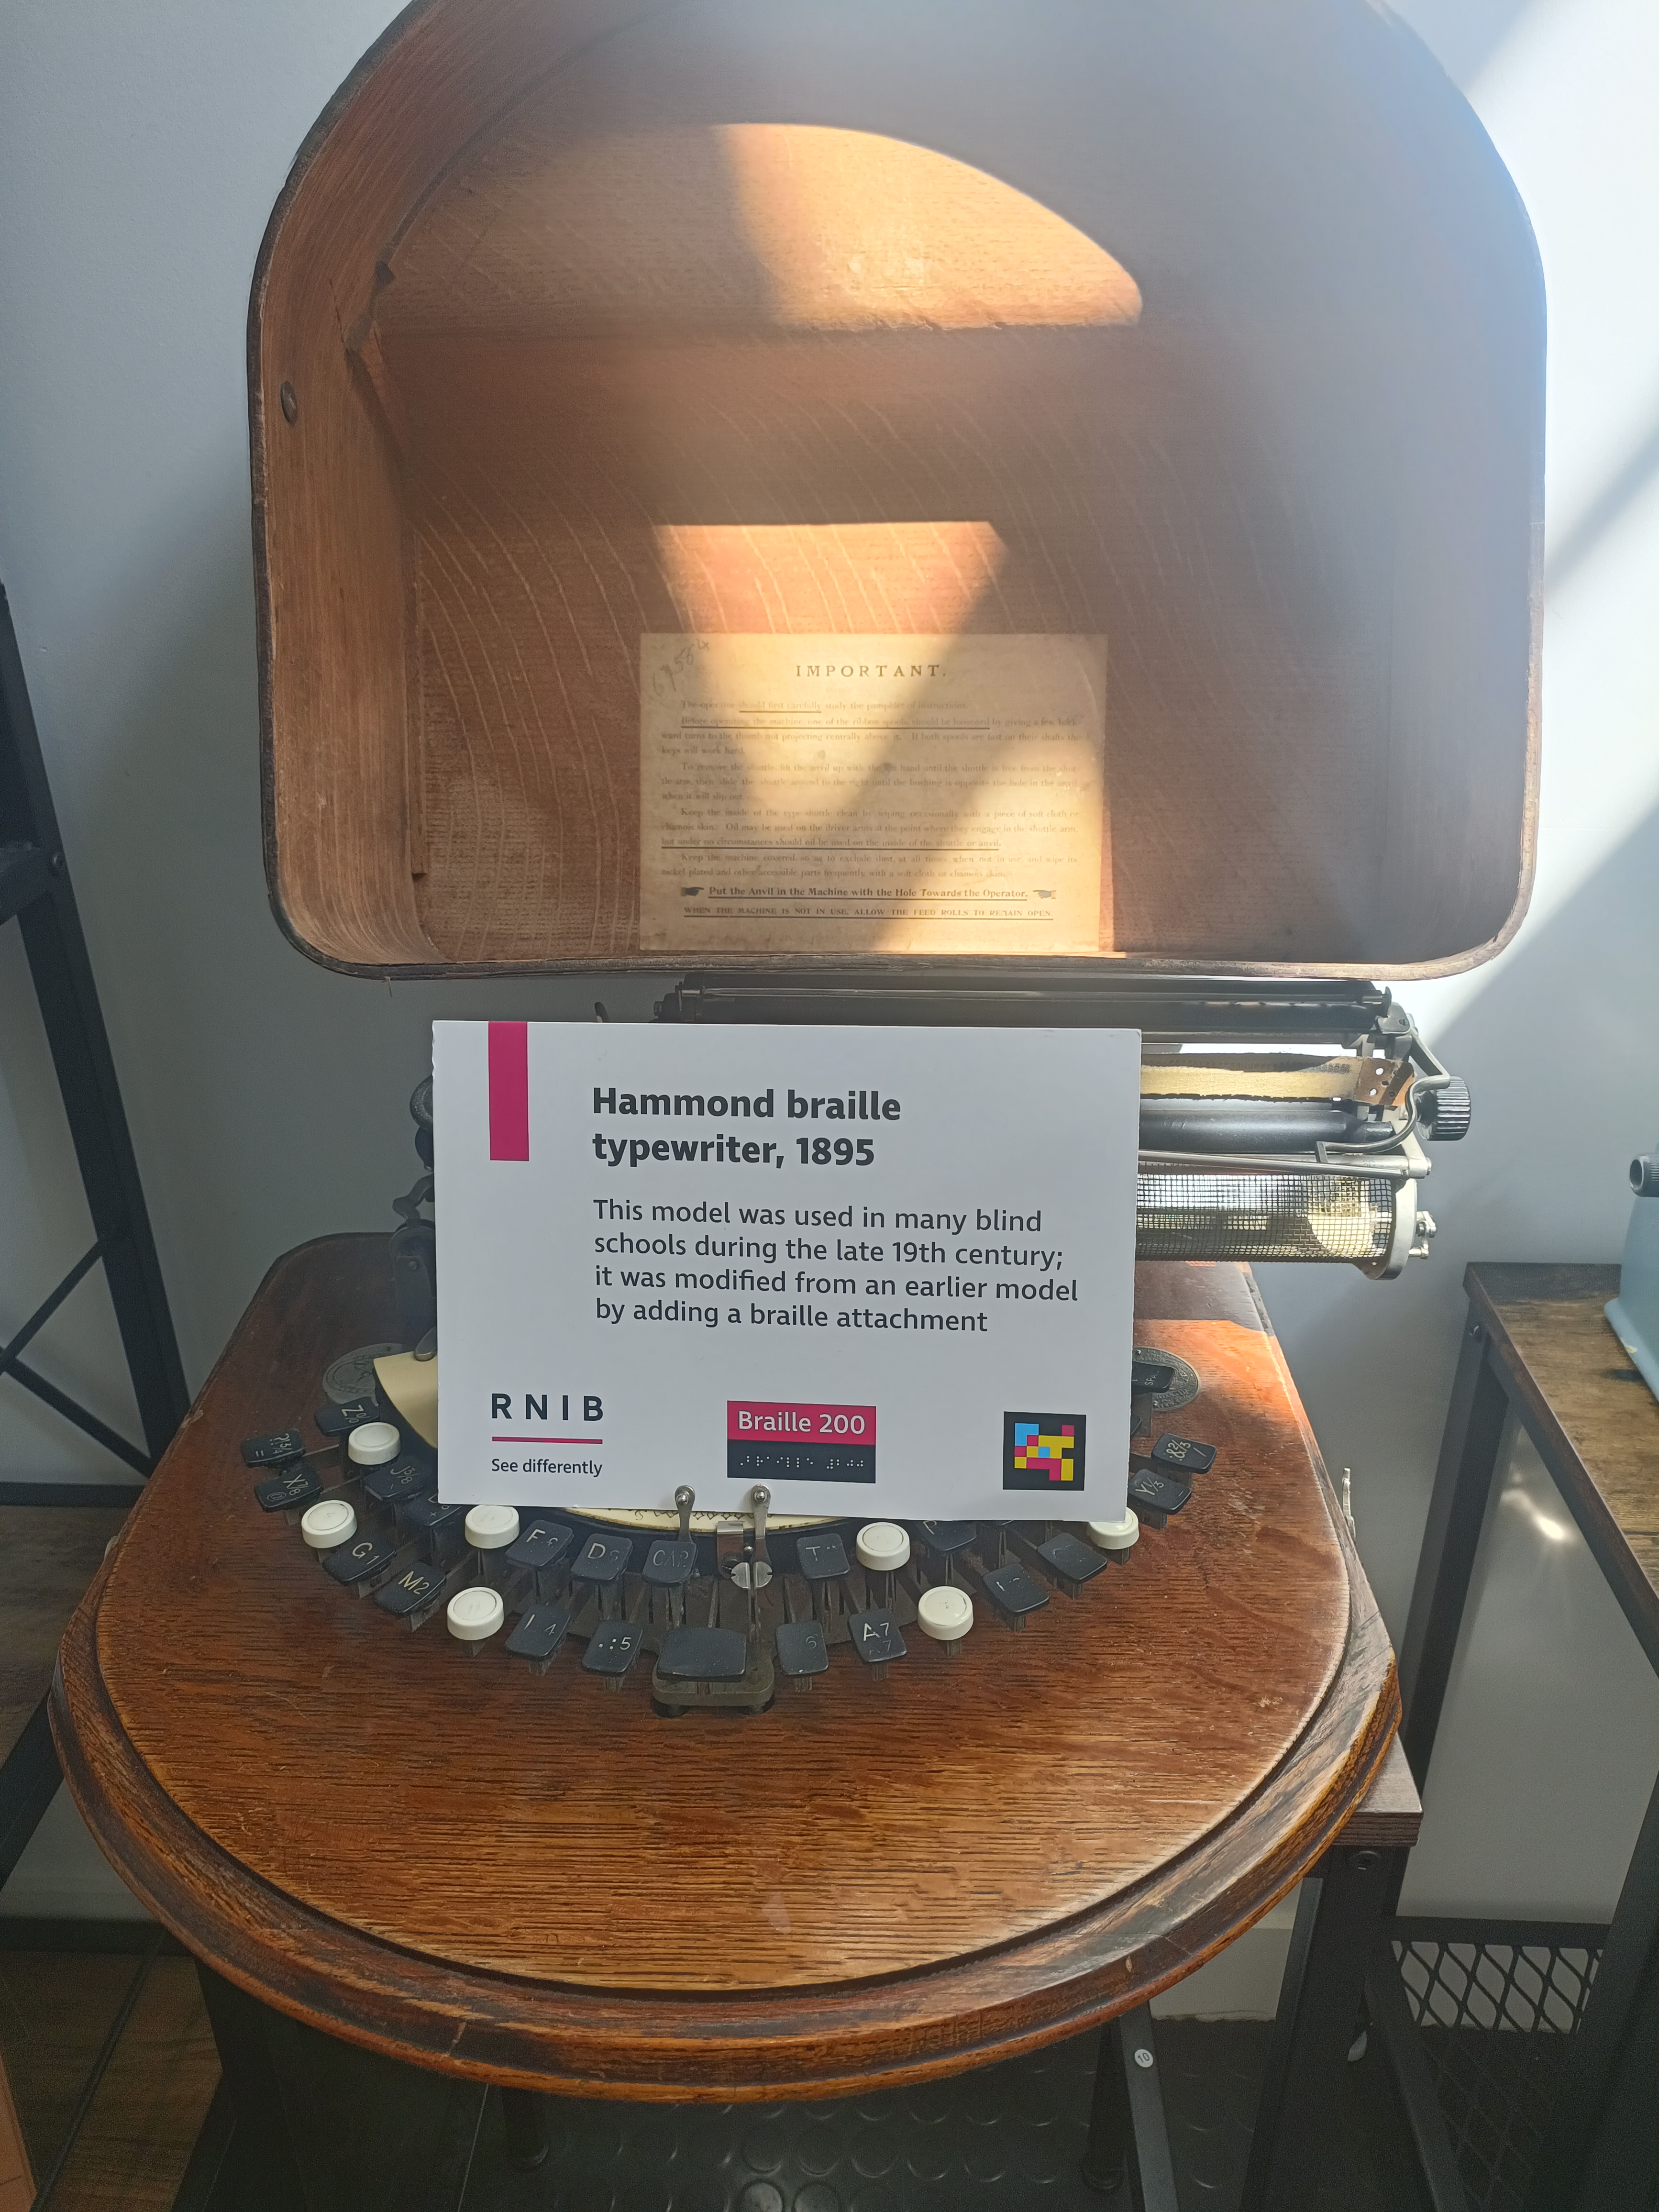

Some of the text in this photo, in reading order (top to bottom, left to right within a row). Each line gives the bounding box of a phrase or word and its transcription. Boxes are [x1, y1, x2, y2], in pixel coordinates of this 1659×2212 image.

[796, 664, 946, 677] IMPORTANT.
[862, 809, 872, 819] by
[878, 809, 906, 819] wiping
[909, 809, 959, 819] occasionally
[994, 810, 1015, 820] piece
[900, 824, 921, 834] point
[951, 824, 969, 834] they
[972, 827, 1002, 835] engage
[717, 838, 773, 846] circumstances
[805, 838, 816, 846] oil
[818, 838, 829, 846] be
[831, 838, 850, 846] used
[882, 839, 906, 847] inside
[909, 839, 918, 847] of
[920, 839, 933, 847] the
[936, 839, 964, 847] shuttle
[978, 839, 1002, 847] anvil.
[661, 868, 686, 876] nickel
[688, 868, 713, 879] plated
[716, 868, 731, 876] and
[733, 868, 754, 876] other
[758, 869, 798, 877] accessible
[801, 870, 821, 879] parts
[824, 869, 865, 879] frequently
[869, 869, 886, 877] with
[896, 869, 912, 877] soft
[914, 869, 935, 877] cloth
[950, 869, 983, 877] chamois
[709, 887, 1029, 899] Put the Anvil in the Machine with the Hole Towards the Operator.
[593, 1087, 901, 1121] Hammond braille
[592, 1133, 874, 1169] typewriter, 1895
[593, 1198, 1041, 1235] This model was used in many blind
[595, 1232, 1062, 1272] schools during the late 19th century;
[596, 1265, 1078, 1301] it was modified from an earlier model
[597, 1297, 988, 1332] by adding a braille attachment
[492, 1393, 603, 1421] RNIB
[738, 1411, 865, 1435] Braille 200
[492, 1458, 603, 1478] See differently
[1138, 2052, 1150, 2063] 10
